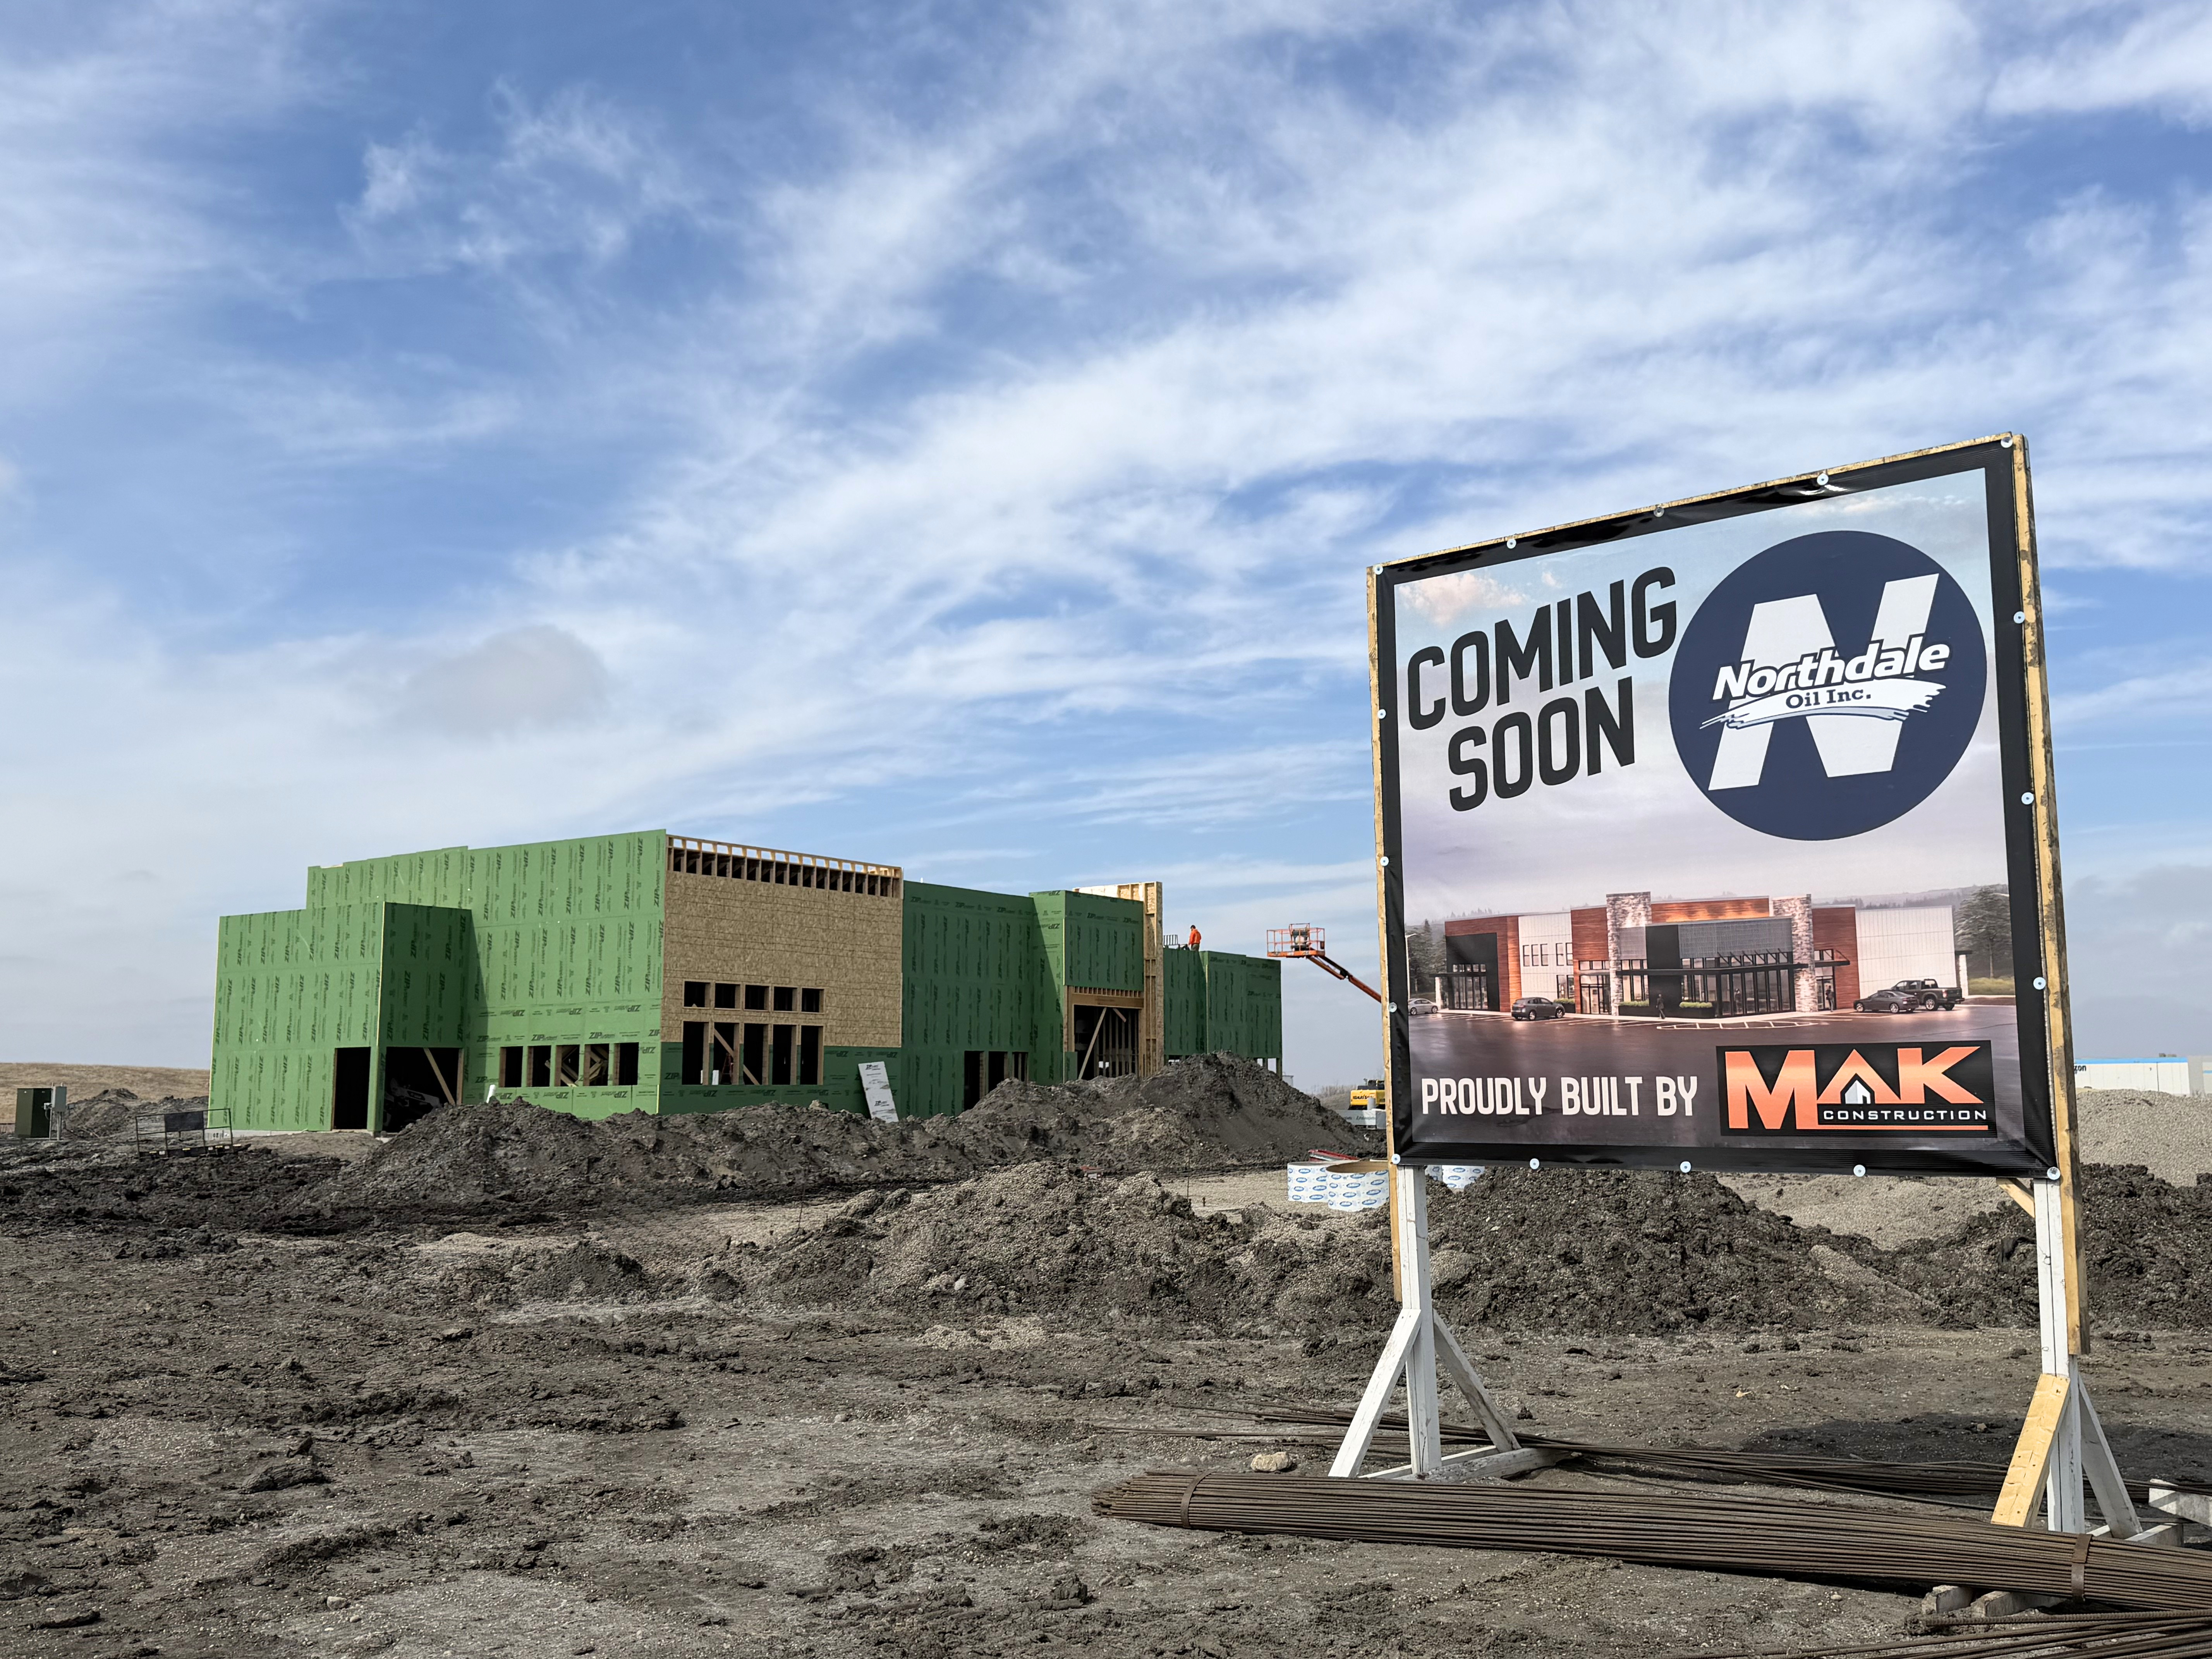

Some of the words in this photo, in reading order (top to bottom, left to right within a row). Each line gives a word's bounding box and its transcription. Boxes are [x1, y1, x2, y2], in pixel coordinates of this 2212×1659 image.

[1408, 567, 1677, 730] COMING
[1712, 636, 1950, 700] Northdale
[1786, 692, 1820, 709] Oil
[1826, 689, 1871, 704] Inc.
[1448, 676, 1635, 812] SOON
[1422, 1077, 1547, 1115] PROUDLY
[1561, 1077, 1643, 1116] BUILT
[1656, 1076, 1698, 1116] BY
[1725, 1046, 1984, 1130] MAK
[1824, 1110, 1987, 1120] CONSTRUCTION
